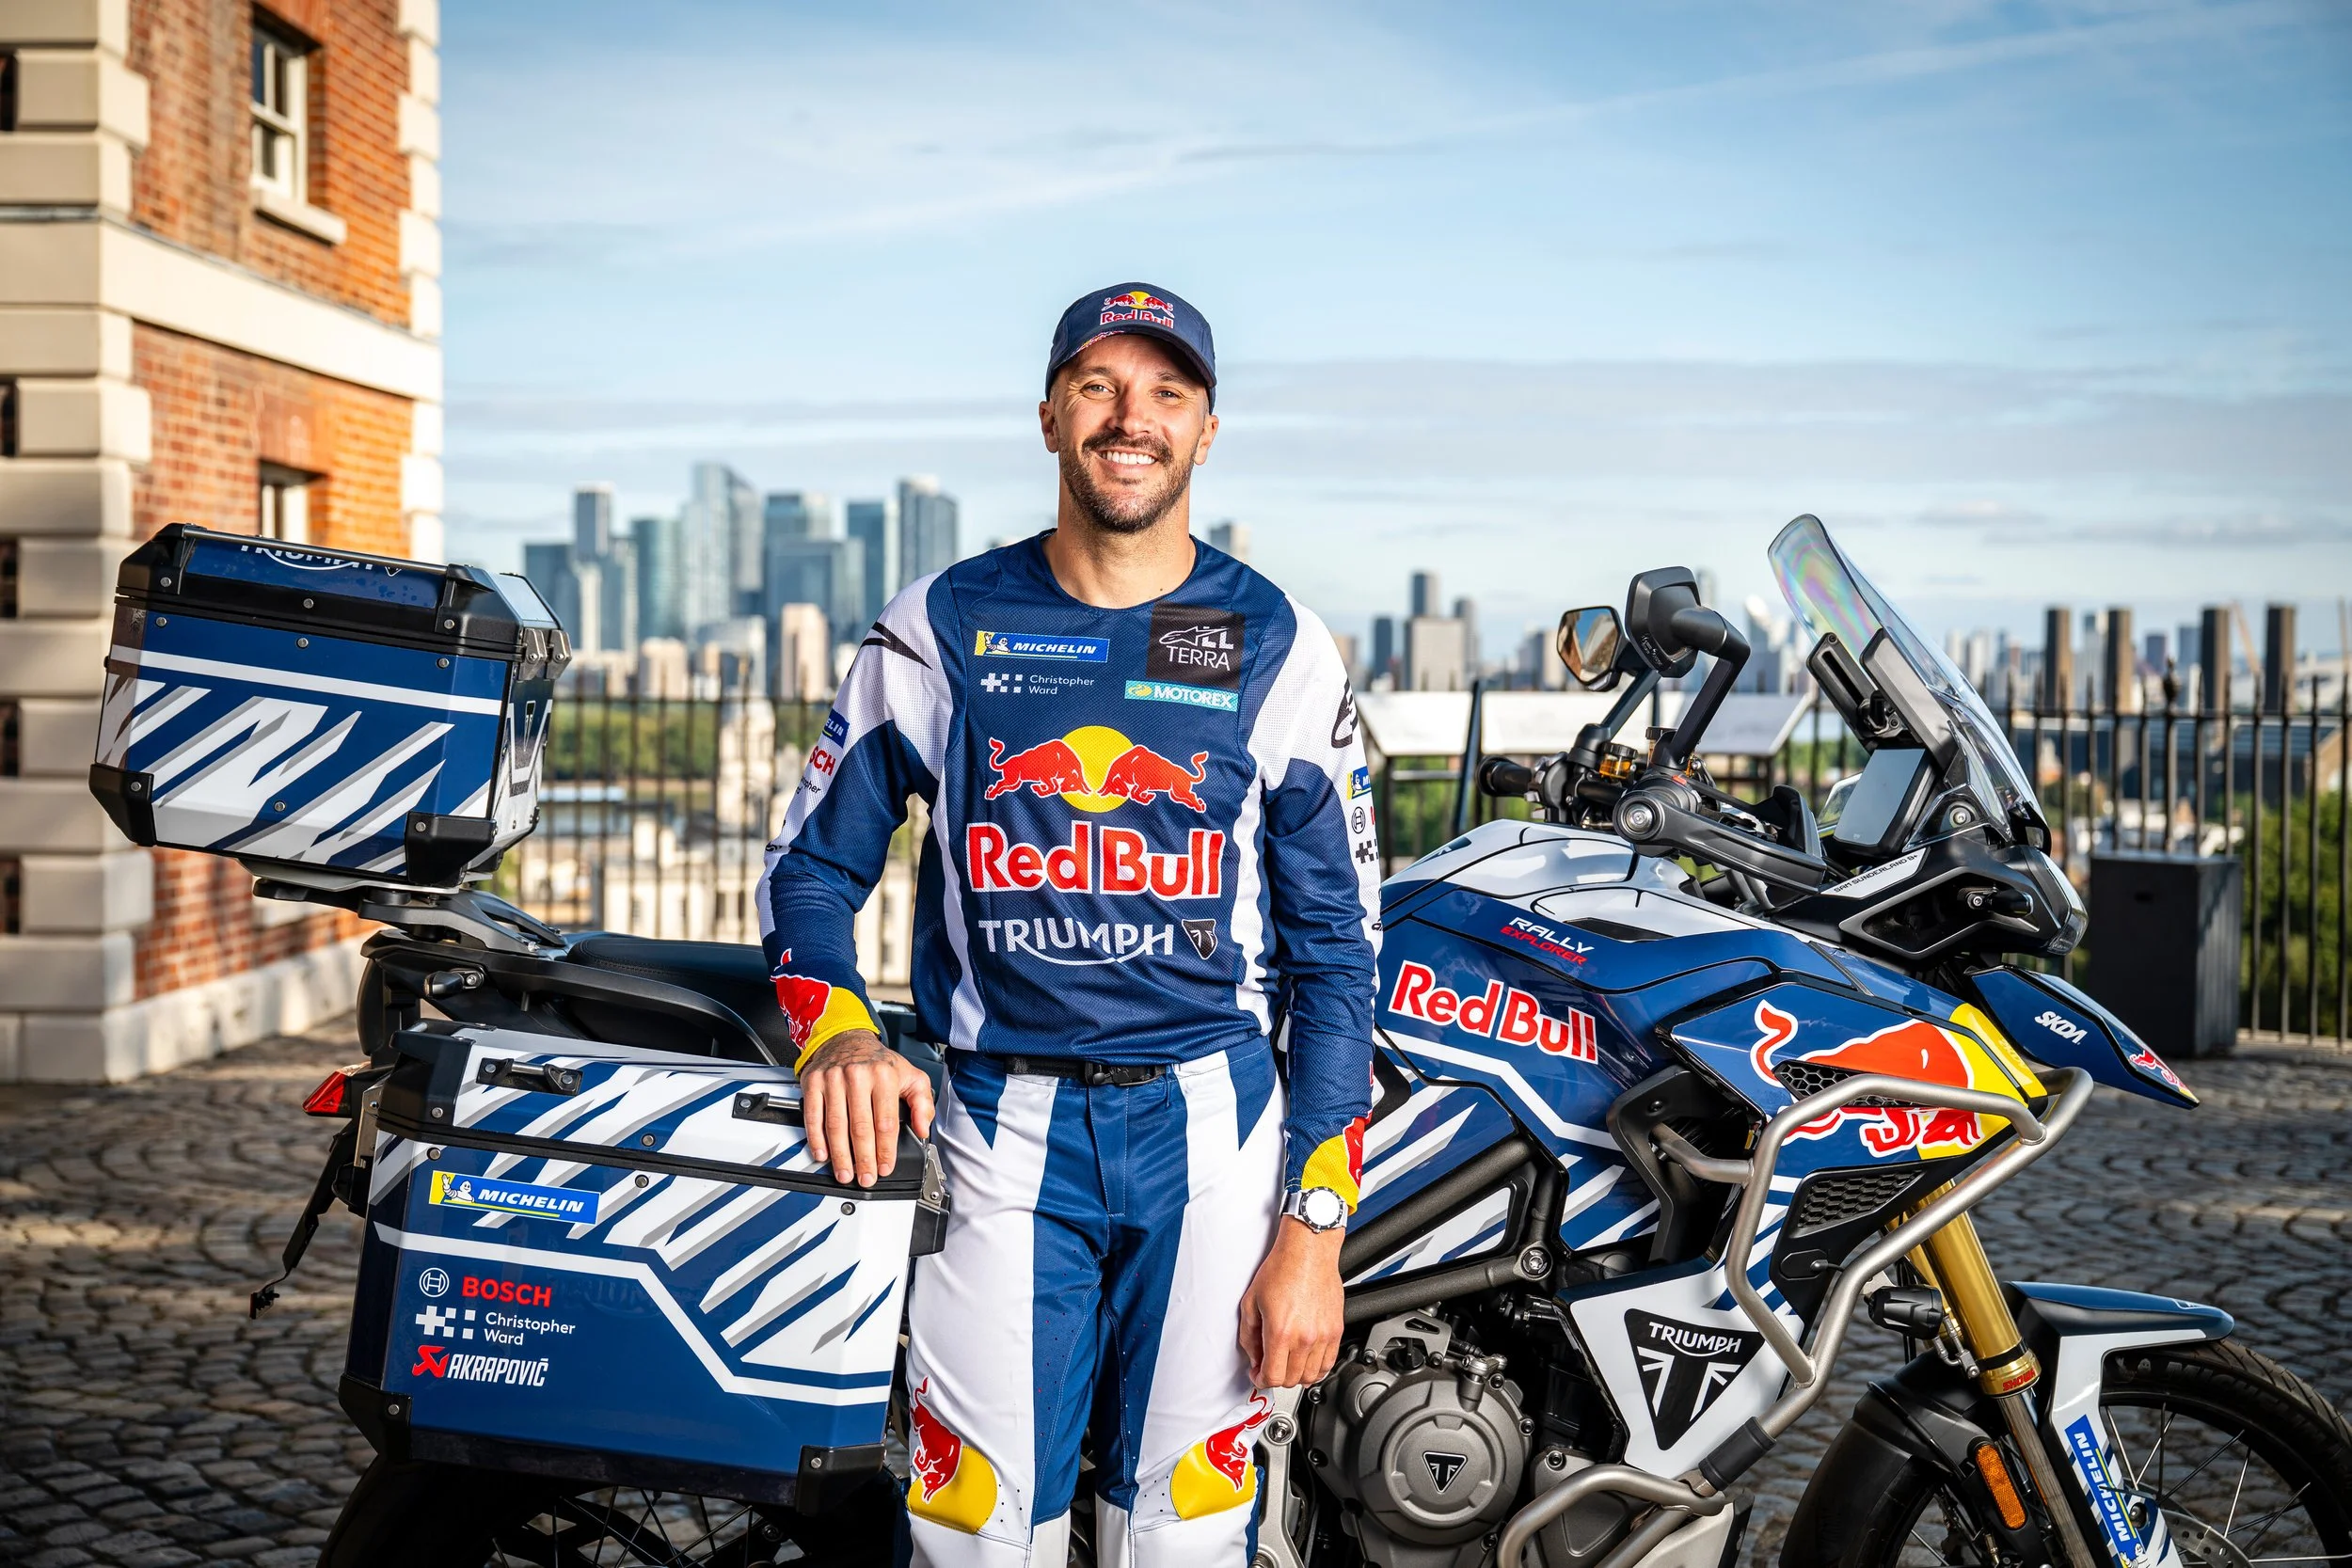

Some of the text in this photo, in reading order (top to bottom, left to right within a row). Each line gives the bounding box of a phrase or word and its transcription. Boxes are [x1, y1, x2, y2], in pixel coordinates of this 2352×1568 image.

[1100, 309, 1174, 329] Red Bull
[1013, 641, 1097, 655] MICHELIN
[1167, 645, 1231, 672] TERRA
[1028, 686, 1057, 695] Ward
[1029, 674, 1095, 687] Christopher
[1153, 685, 1232, 707] MOTOREX
[966, 819, 1226, 901] Red Bull
[1834, 882, 1852, 893] SAM
[1851, 858, 1907, 884] SUNDERLAND
[977, 917, 1174, 965] TRIUMPH
[1500, 926, 1589, 967] EXPLORER
[1508, 916, 1596, 954] RALLY
[1388, 959, 1598, 1065] Red Bull
[2034, 1010, 2088, 1044] SKDA
[477, 1188, 584, 1213] MICHELIN
[461, 1275, 552, 1308] BOSCH
[484, 1328, 524, 1346] Ward
[485, 1311, 576, 1335] Christopher
[1648, 1322, 1741, 1357] TRIUMPH
[2074, 1432, 2131, 1543] MICHELIN
